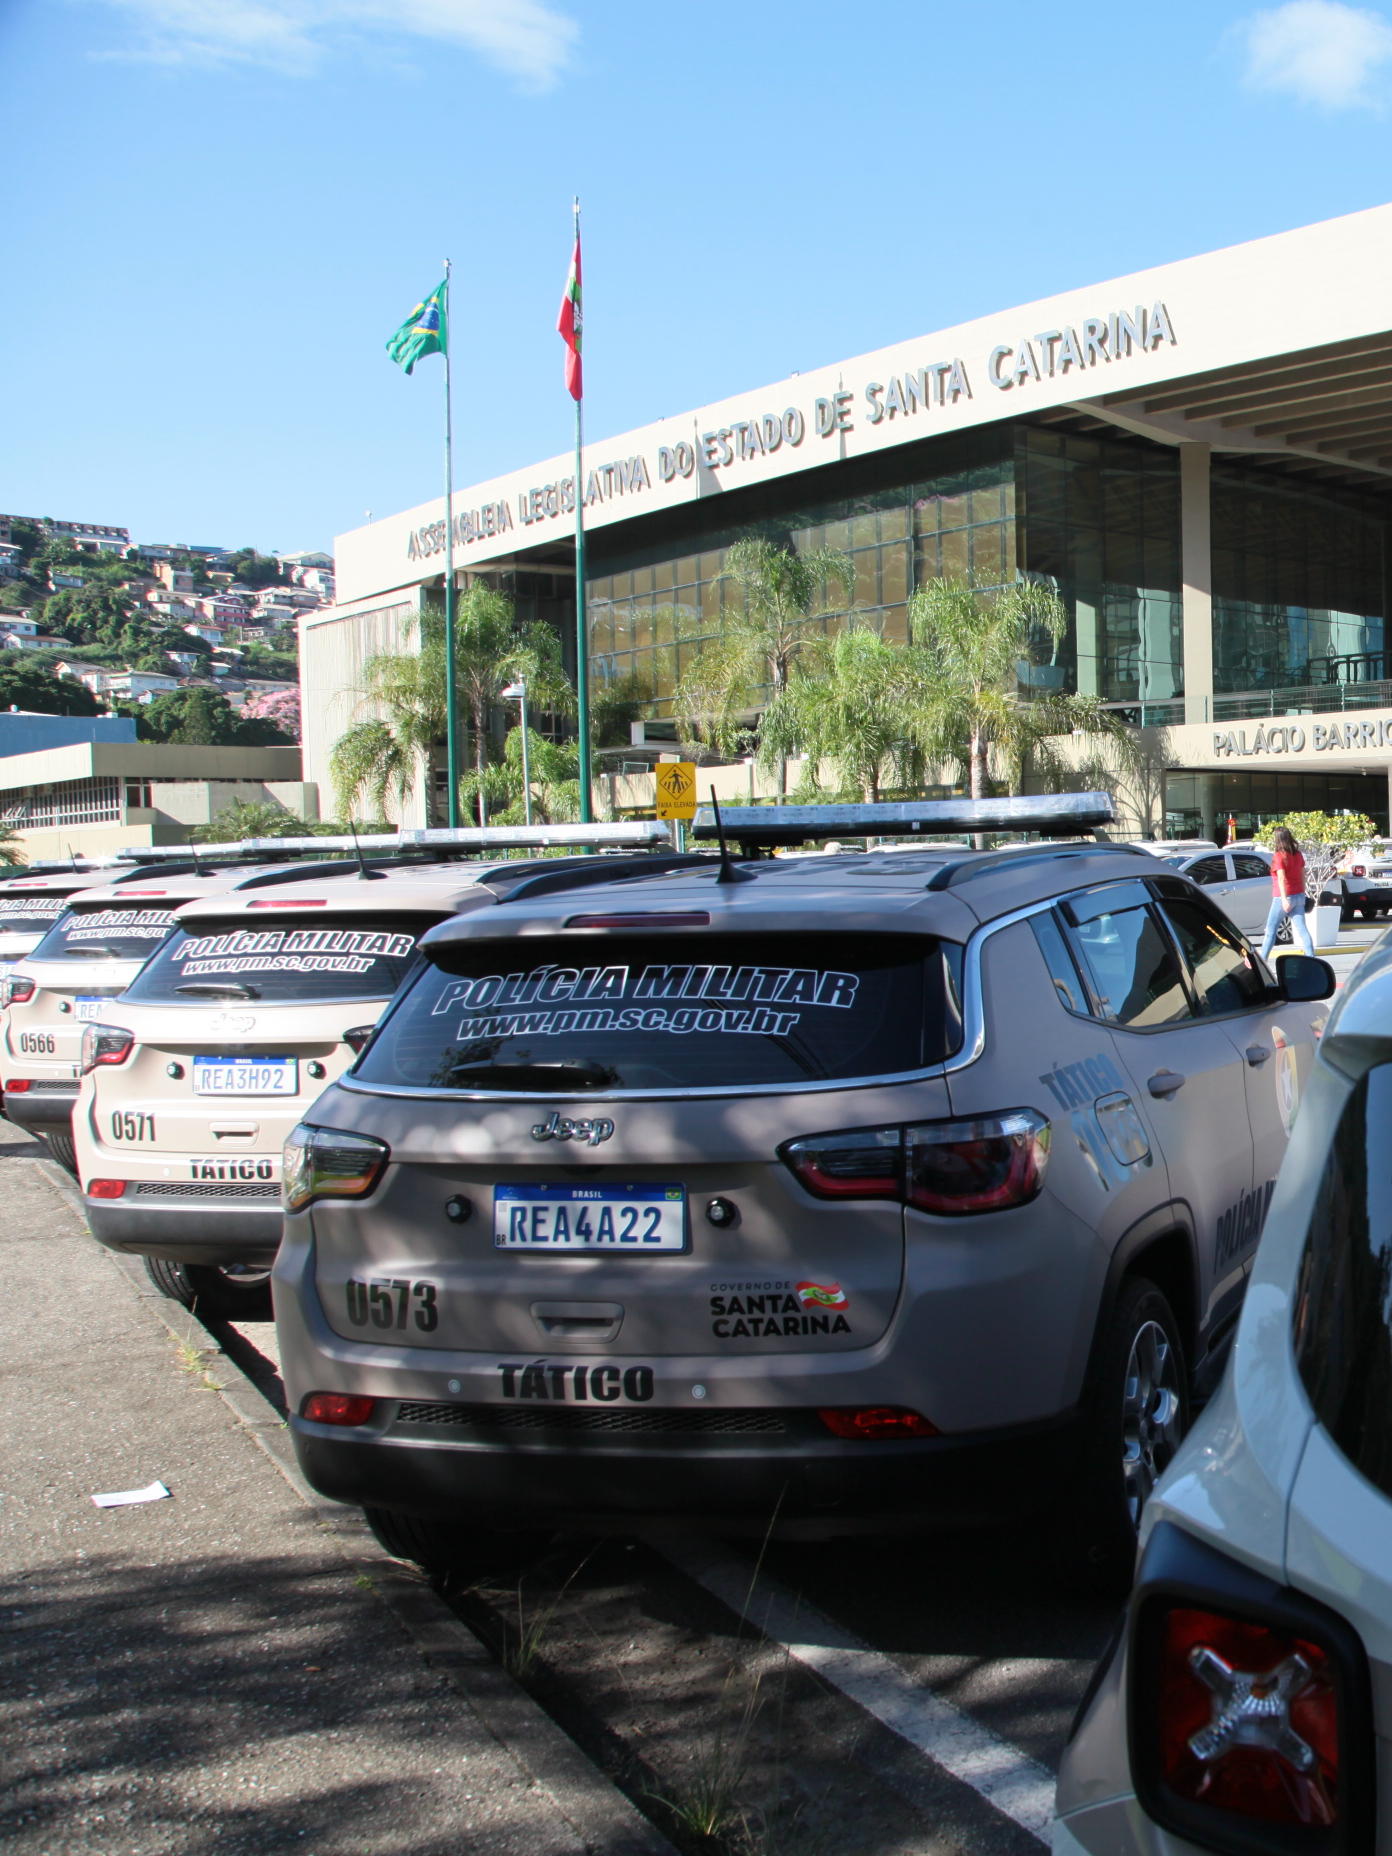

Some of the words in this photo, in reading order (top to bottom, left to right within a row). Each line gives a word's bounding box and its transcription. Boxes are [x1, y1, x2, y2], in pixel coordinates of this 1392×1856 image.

[658, 440, 695, 482] DO
[702, 406, 805, 468] ESTADO
[815, 390, 854, 439] DE
[865, 357, 973, 423] SANTA
[988, 299, 1177, 391] CATARINA
[1213, 723, 1305, 757] PALÁCIO
[674, 801, 696, 809] ELEVADA
[171, 930, 285, 961] POLÍCIA
[282, 930, 415, 957] MILITAR
[181, 955, 375, 976] www.pm.sc.gov.br
[431, 964, 629, 1015] POLÍCIA
[633, 965, 861, 1008] MILITAR
[456, 1007, 800, 1041] www.pm.sc.gov.br
[20, 1032, 56, 1054] 0566
[202, 1068, 285, 1089] REA3H92
[1038, 1052, 1124, 1113] TÁTICO
[112, 1110, 157, 1142] 0571
[531, 1111, 615, 1147] Jeep
[572, 1190, 602, 1199] BRASIL
[496, 1234, 507, 1246] BR
[510, 1206, 662, 1243] REA4A22
[710, 1281, 772, 1292] GOVERNO
[775, 1281, 791, 1290] DE
[345, 1274, 439, 1333] 0573
[710, 1293, 801, 1317] SANTA
[712, 1314, 852, 1338] CATARINA
[497, 1358, 654, 1402] TÁTICO
